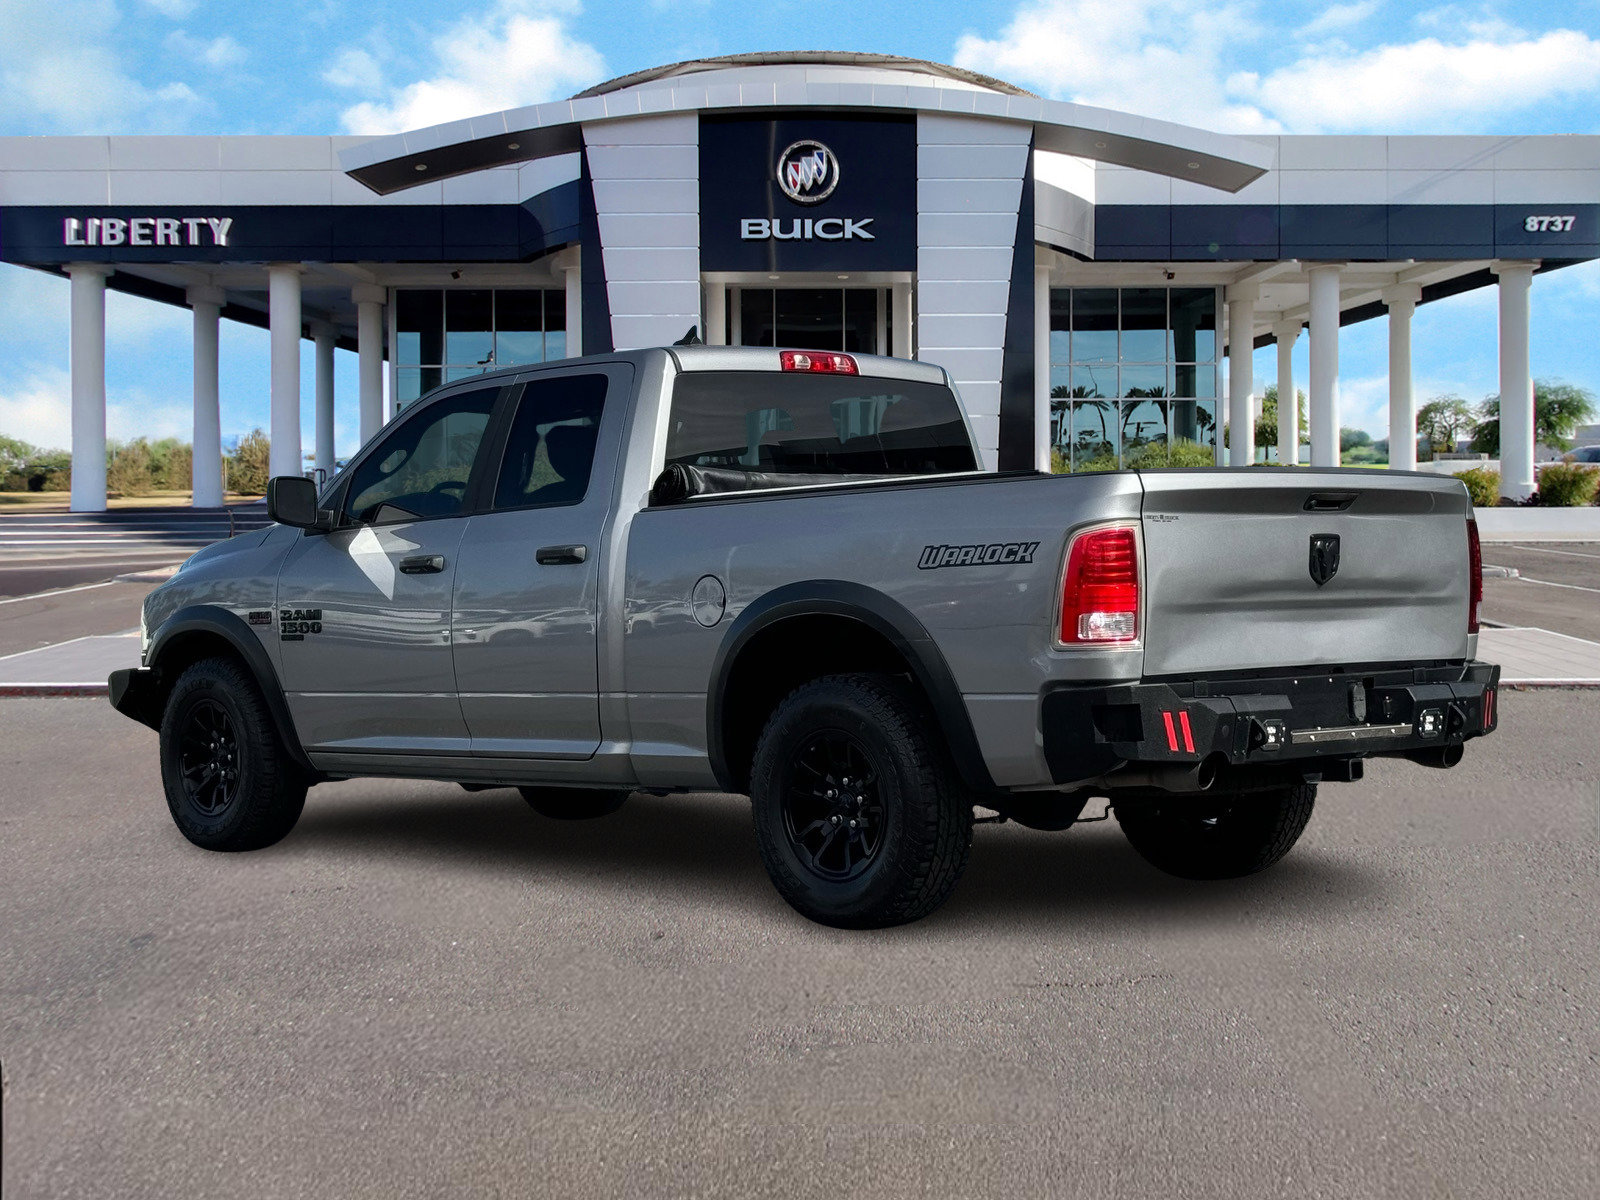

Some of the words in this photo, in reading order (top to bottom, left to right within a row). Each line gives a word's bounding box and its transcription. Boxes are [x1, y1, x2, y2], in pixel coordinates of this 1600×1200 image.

[63, 217, 233, 247] LIBERTY
[740, 218, 876, 240] BUICK
[1524, 215, 1577, 233] 8737
[917, 541, 1041, 571] WARLOCK
[280, 609, 323, 621] RAM
[281, 621, 323, 634] 1500
